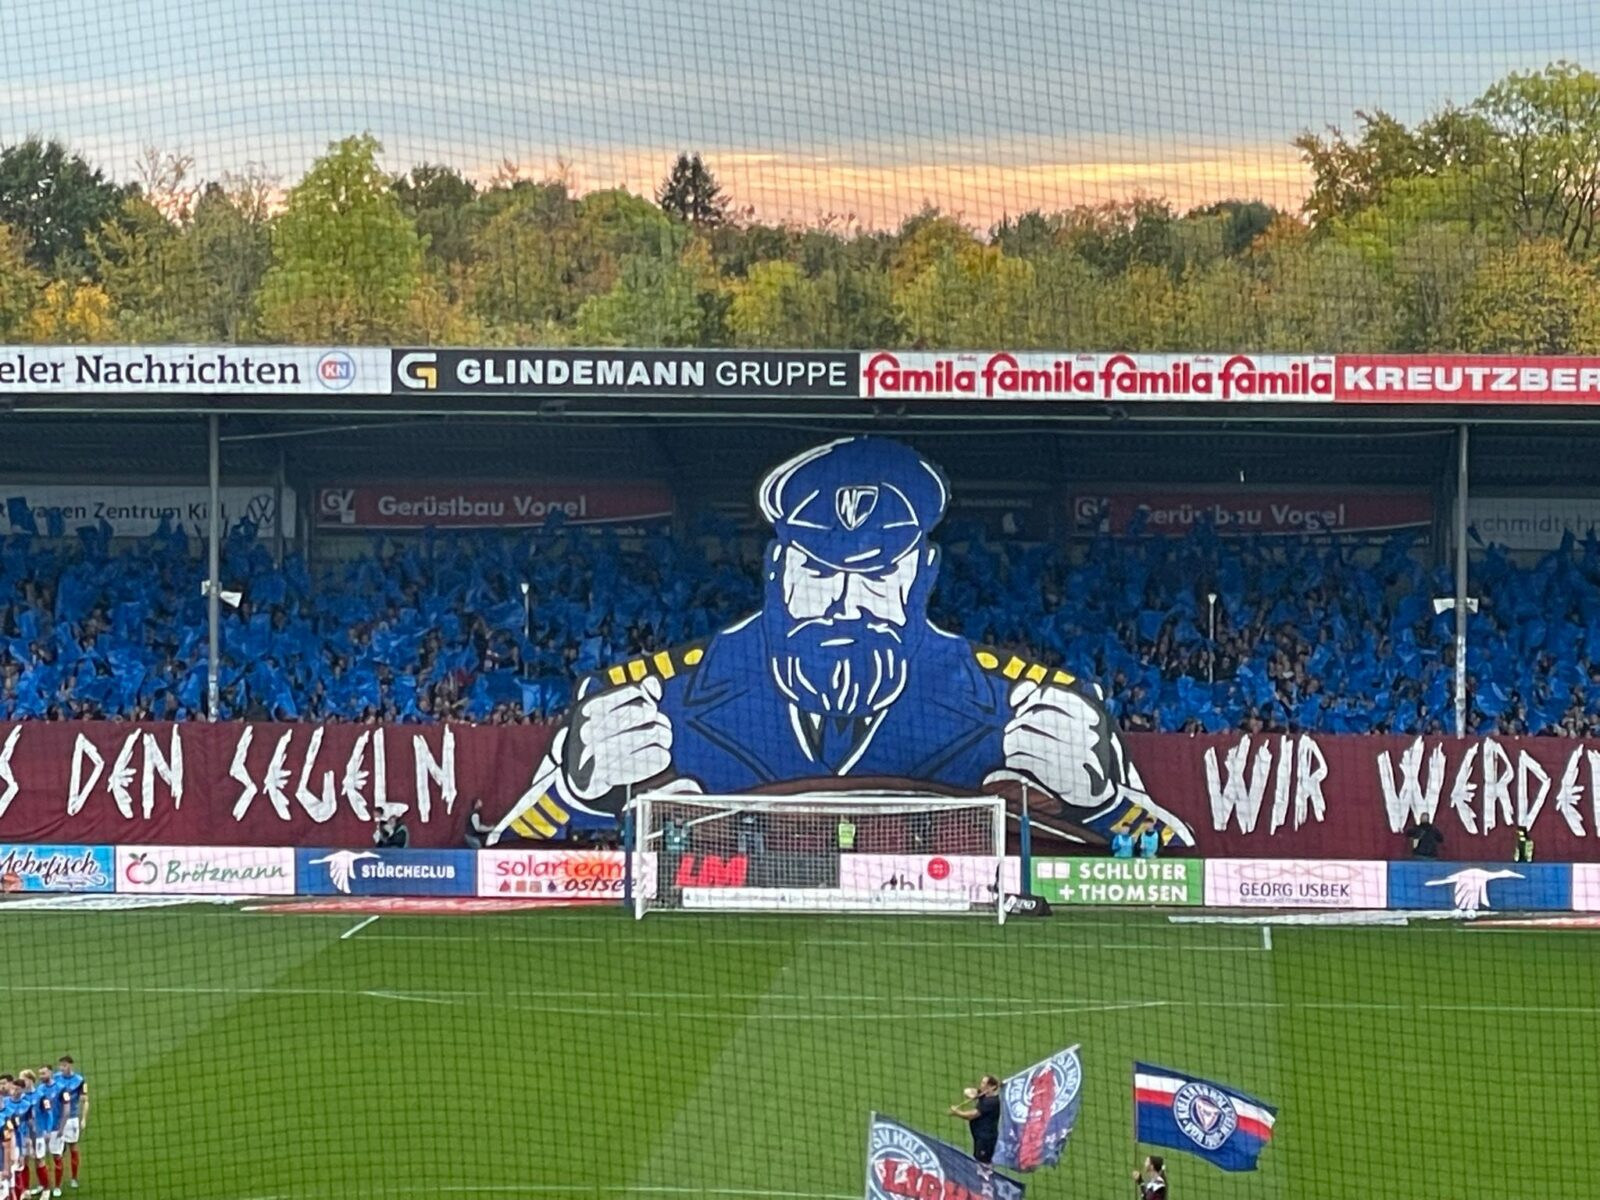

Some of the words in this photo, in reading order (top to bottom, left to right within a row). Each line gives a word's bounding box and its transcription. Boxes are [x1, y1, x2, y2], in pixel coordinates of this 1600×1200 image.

[75, 353, 301, 384] Nachrichten
[456, 358, 705, 386] GLINDEMANN
[715, 361, 847, 387] GRUPPE
[863, 352, 975, 397] famila
[981, 352, 1095, 397] famila
[1099, 354, 1213, 398] famila
[1218, 354, 1332, 399] famila
[188, 503, 226, 519] Kil
[378, 495, 504, 517] Gerüstbau
[67, 724, 183, 819] DEN
[229, 724, 457, 823] SEGELN
[1205, 734, 1328, 835] WIR
[165, 861, 286, 885] Brötzmann
[362, 861, 455, 879] STÖRCHECLUB
[1079, 858, 1186, 880] SCHLÜTER
[1079, 884, 1188, 903] THOMSEN
[1239, 882, 1293, 898] GEORG
[1299, 882, 1350, 898] USBEK
